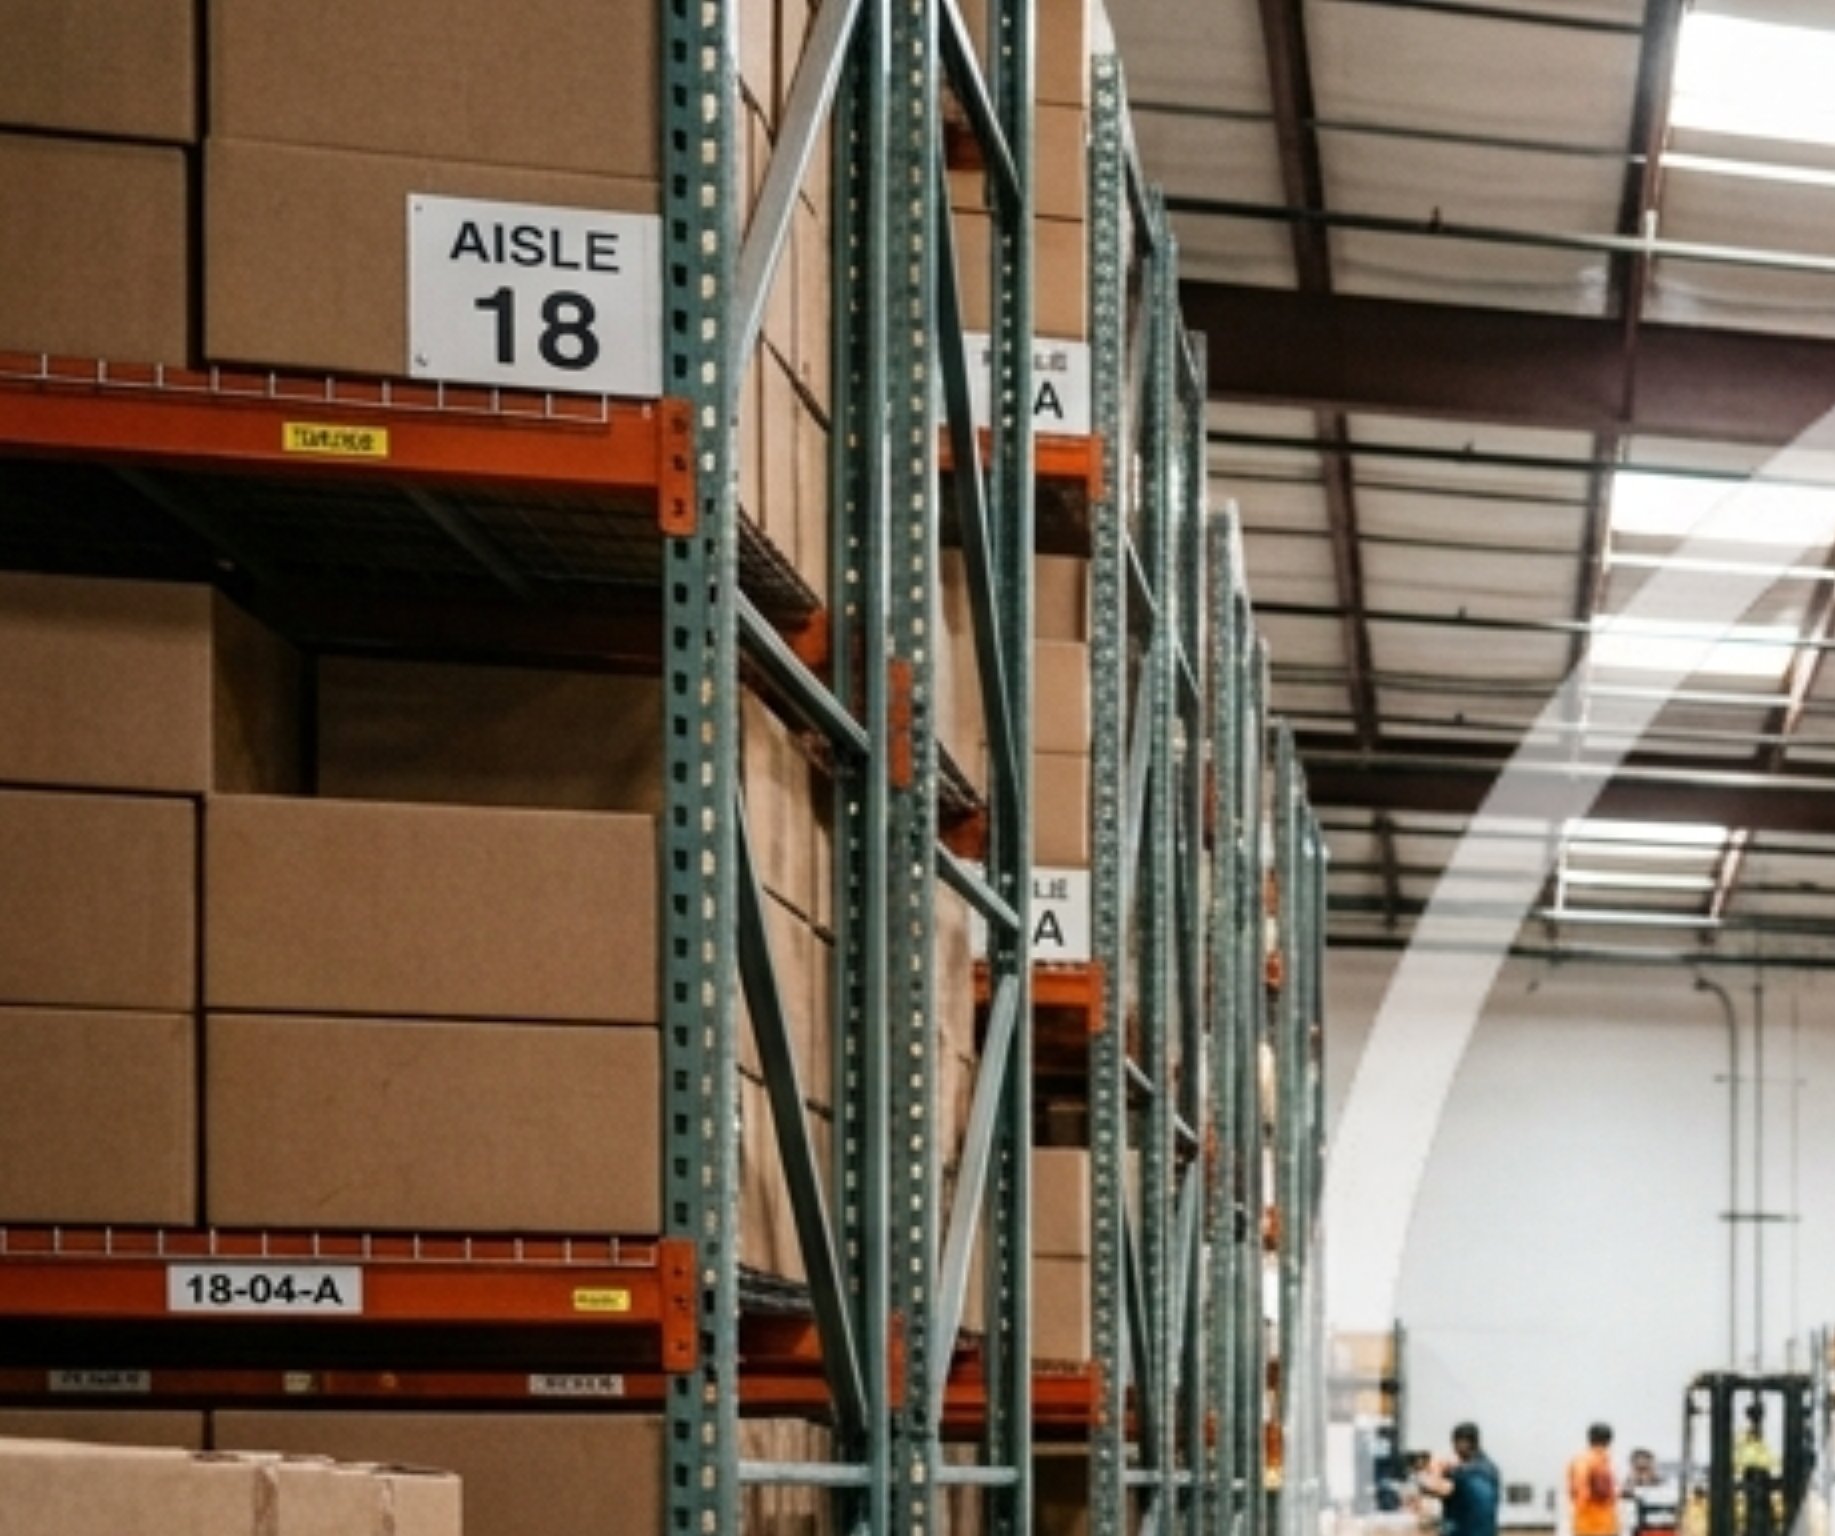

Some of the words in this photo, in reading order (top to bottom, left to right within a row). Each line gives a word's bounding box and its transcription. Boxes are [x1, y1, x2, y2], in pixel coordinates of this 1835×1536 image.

[449, 220, 620, 274] AISLE
[474, 286, 600, 371] 18
[186, 1273, 343, 1306] 18-04-A
